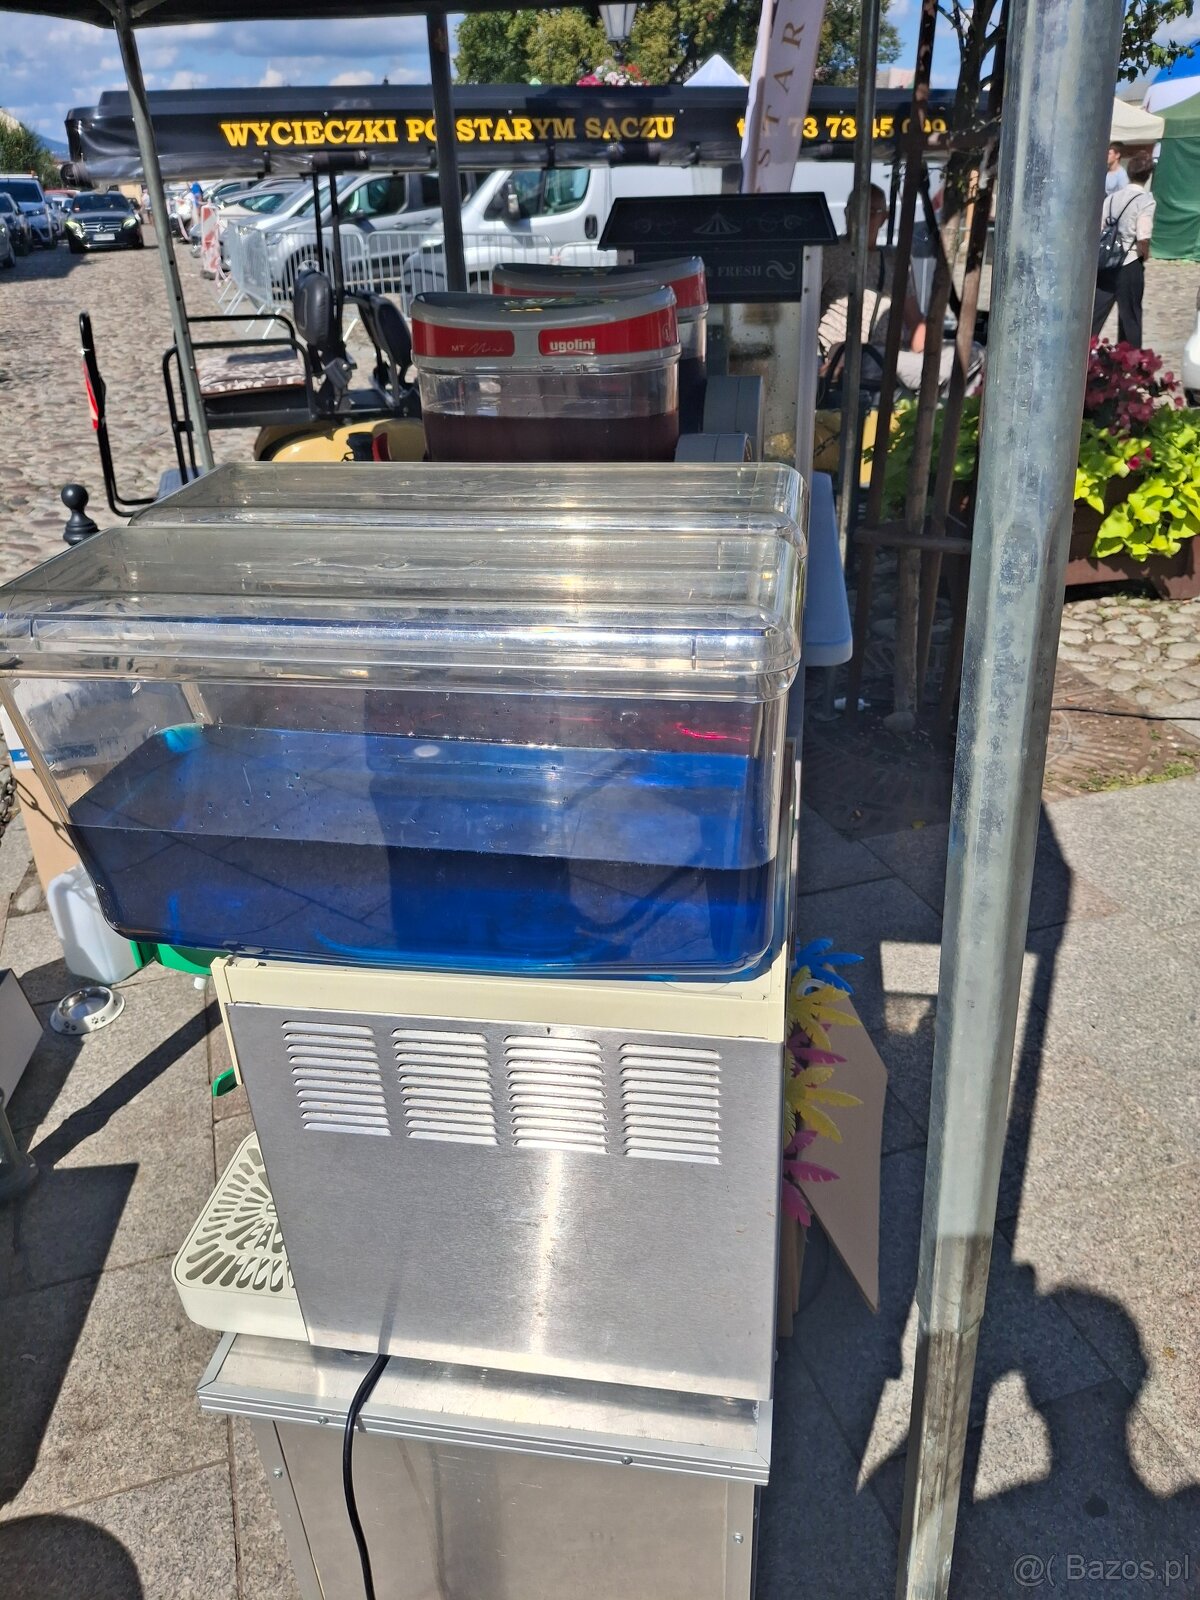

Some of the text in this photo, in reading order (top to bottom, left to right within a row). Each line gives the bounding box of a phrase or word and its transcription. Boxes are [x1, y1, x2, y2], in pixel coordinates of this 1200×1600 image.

[220, 119, 399, 147] WYCIECZKI
[455, 117, 577, 142] STARYM
[825, 117, 857, 138] 73
[717, 265, 762, 277] FRESH
[451, 344, 465, 352] MT
[549, 337, 596, 353] ugolini
